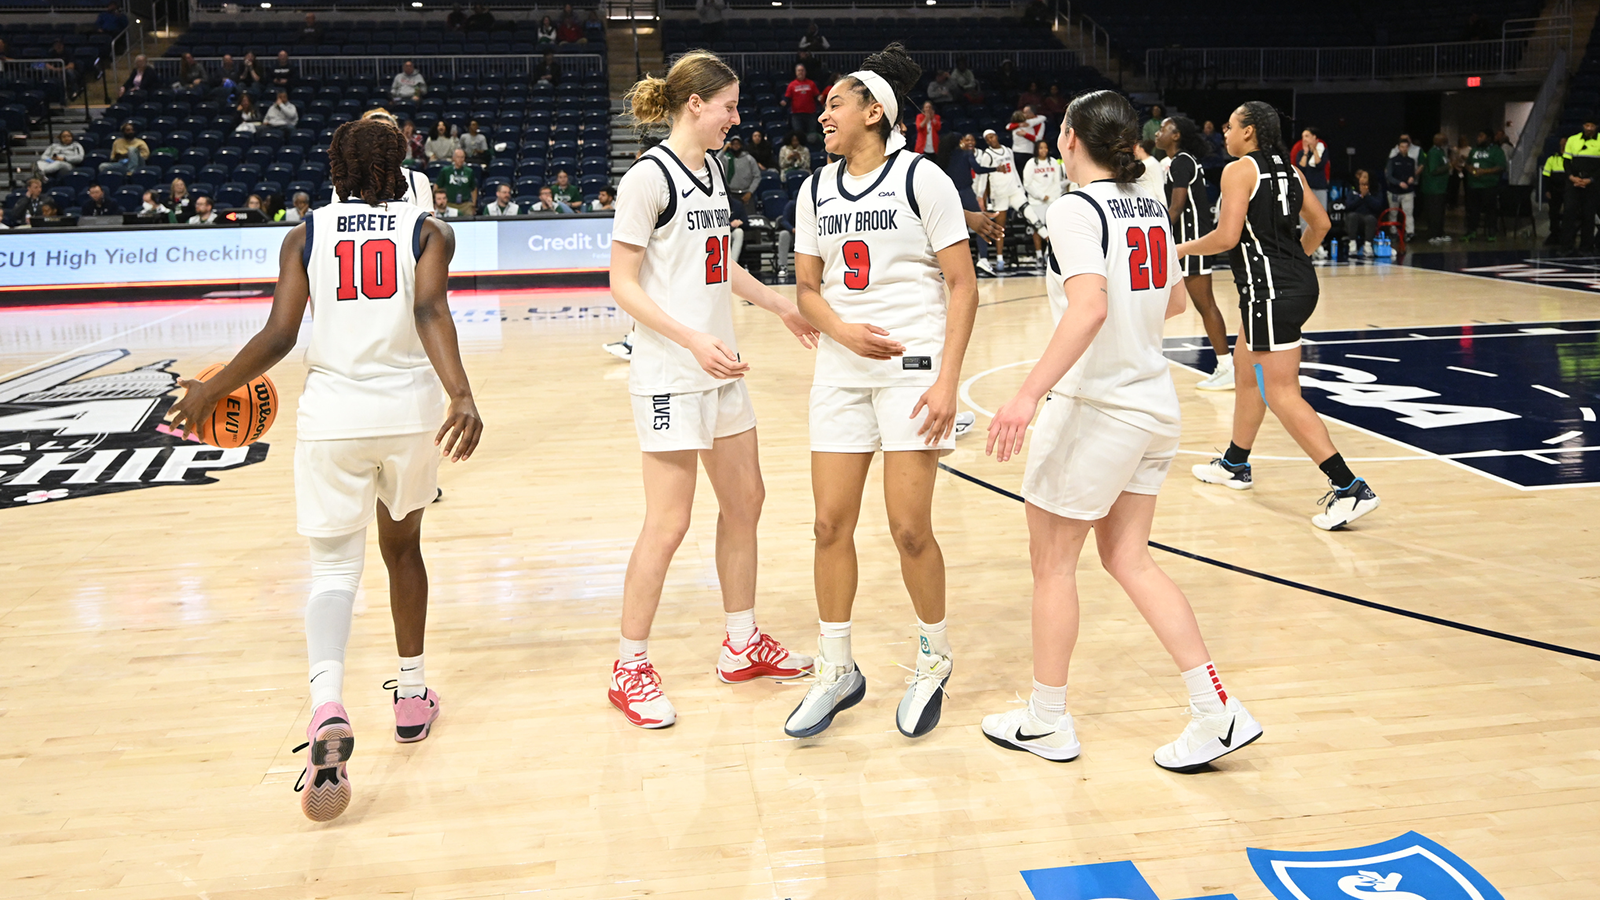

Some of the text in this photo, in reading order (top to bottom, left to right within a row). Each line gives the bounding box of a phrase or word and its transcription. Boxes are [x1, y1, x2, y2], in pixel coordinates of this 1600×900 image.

[337, 213, 397, 233] BERETE
[687, 209, 715, 231] STONY
[818, 209, 898, 236] STONY BROOK
[46, 249, 97, 270] High
[105, 247, 158, 265] Yield
[165, 245, 268, 264] Checking
[528, 233, 593, 251] Credit
[705, 234, 729, 285] 21
[1126, 225, 1168, 291] 20
[334, 238, 398, 301] 10
[842, 239, 871, 291] 9
[246, 380, 272, 442] Wilson
[652, 393, 671, 430] OLVES
